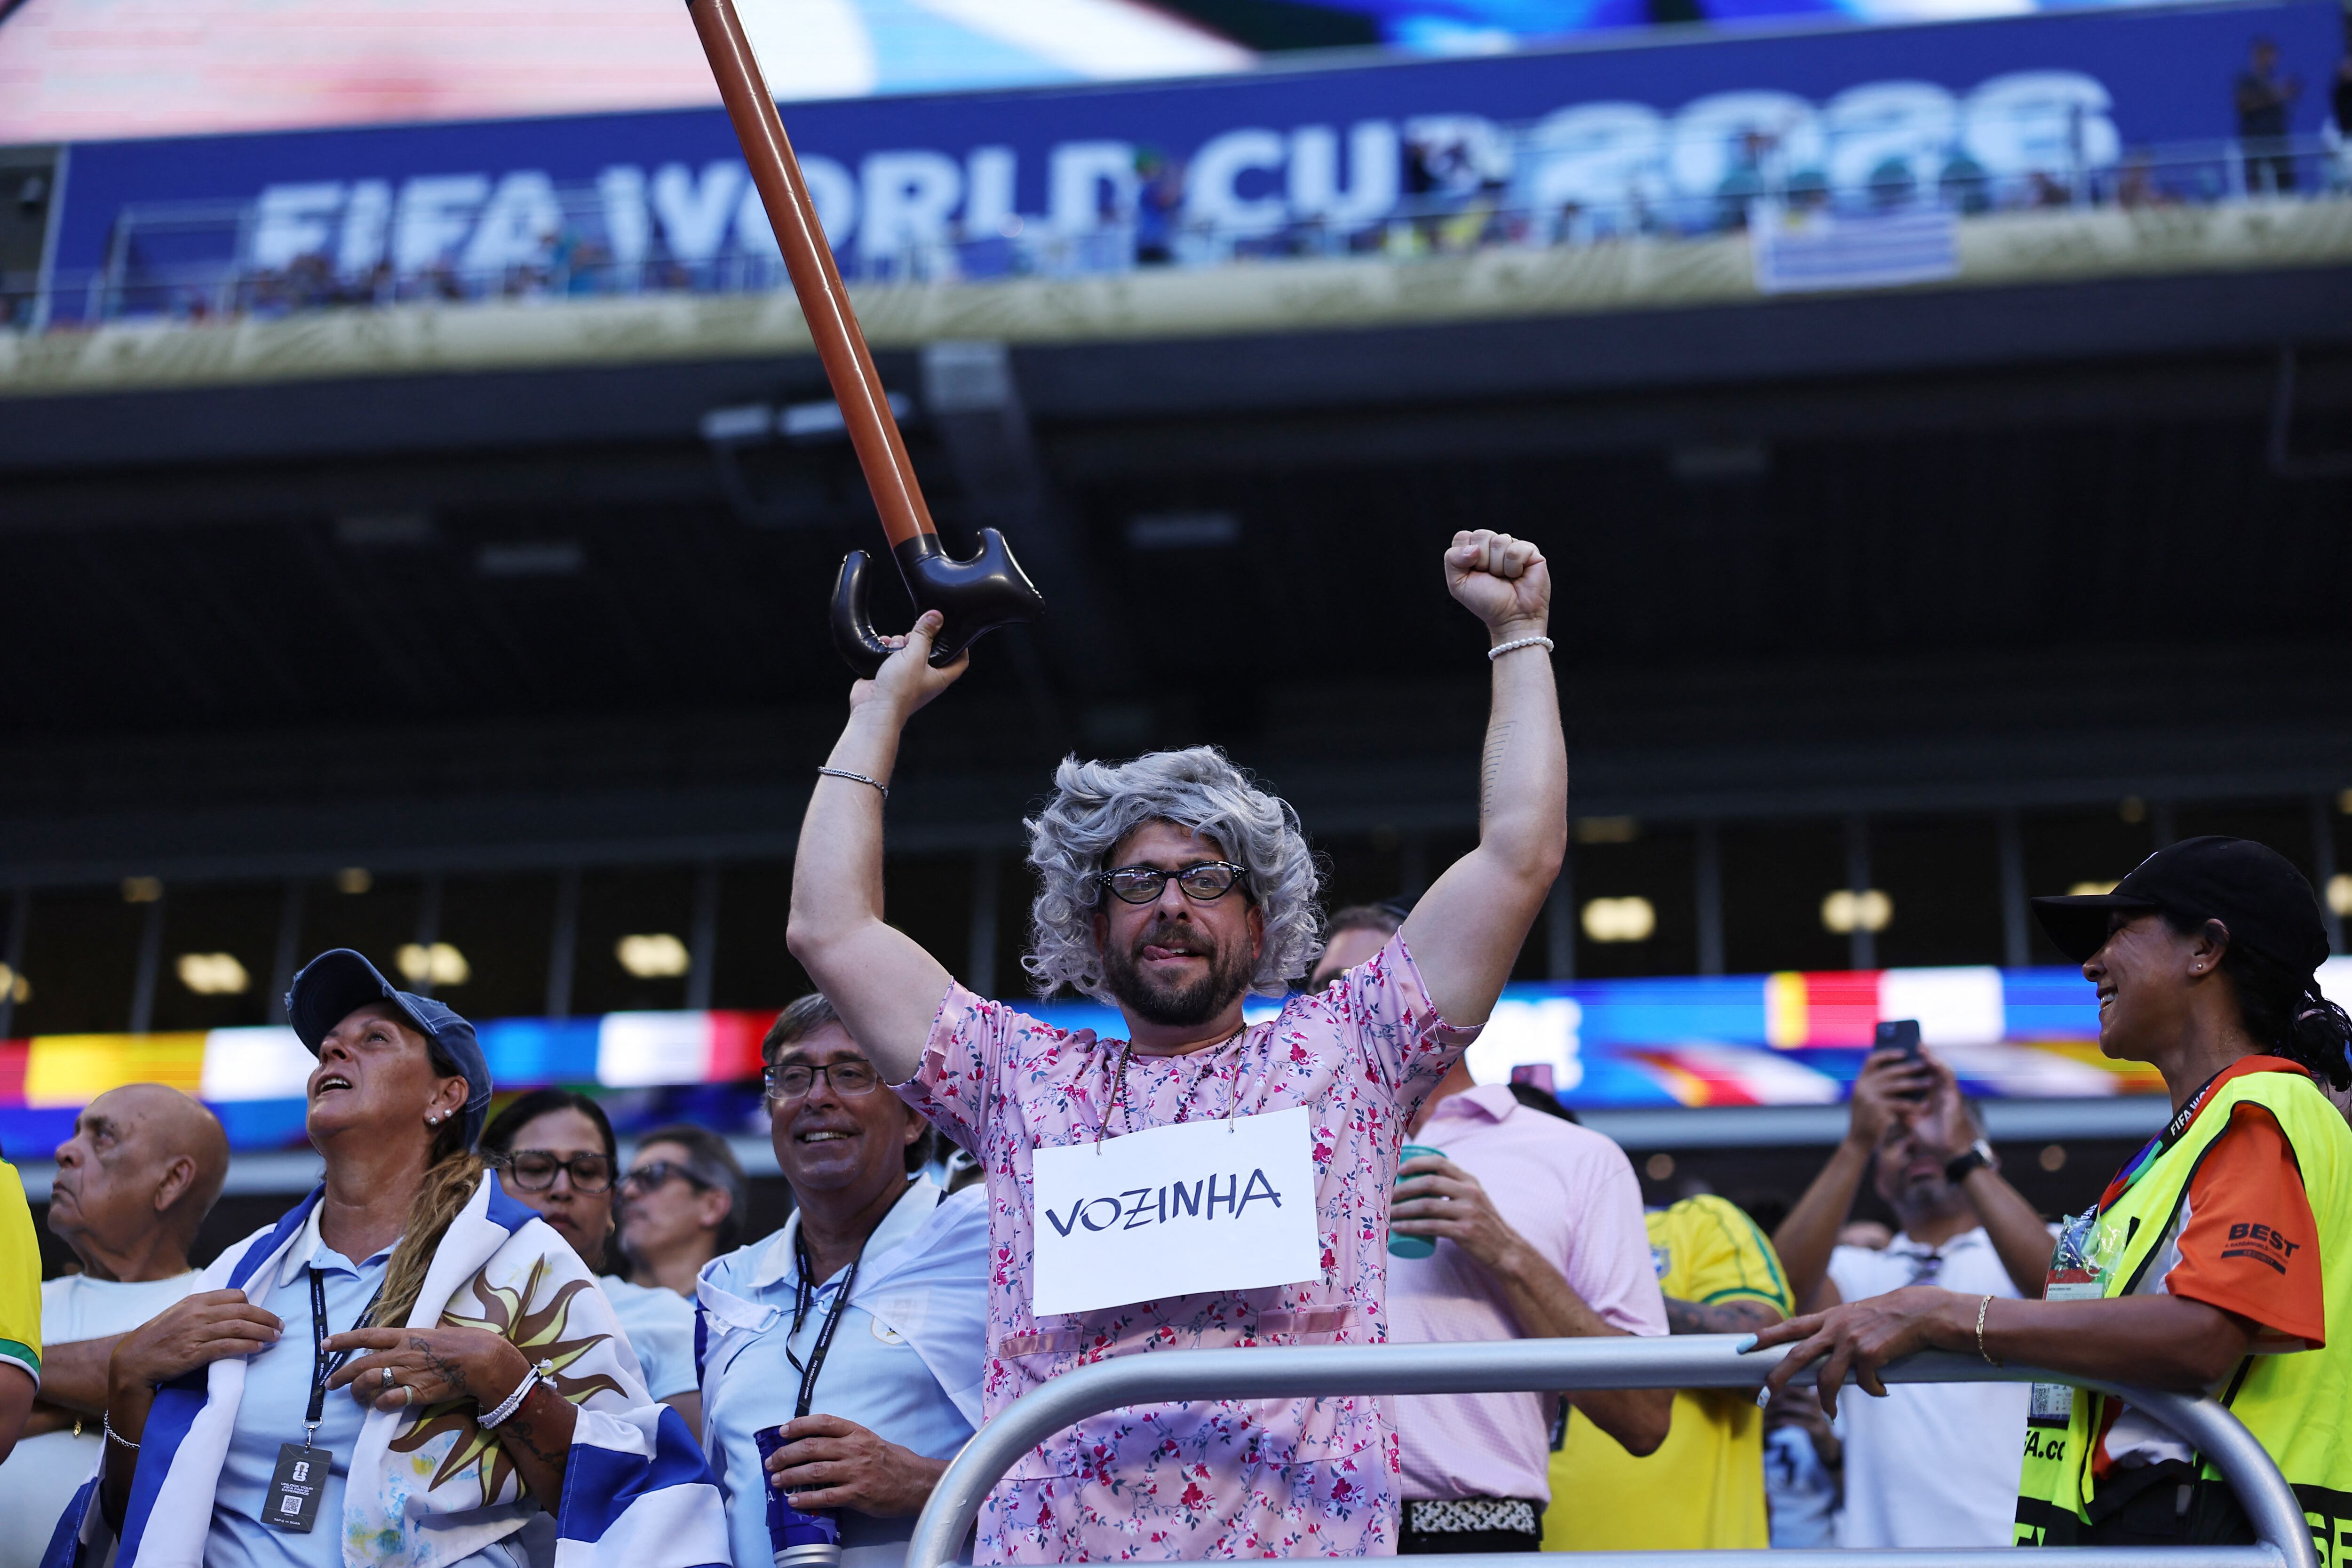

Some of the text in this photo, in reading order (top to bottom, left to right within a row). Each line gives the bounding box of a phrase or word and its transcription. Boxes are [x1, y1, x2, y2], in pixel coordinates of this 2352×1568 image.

[254, 71, 2119, 282] FIFA WORLD CUP 2026
[2170, 1109, 2193, 1136] FIFA
[1045, 1168, 1282, 1238] VOZINHA
[2080, 1203, 2098, 1220] FIFA
[2228, 1223, 2300, 1258] BEST
